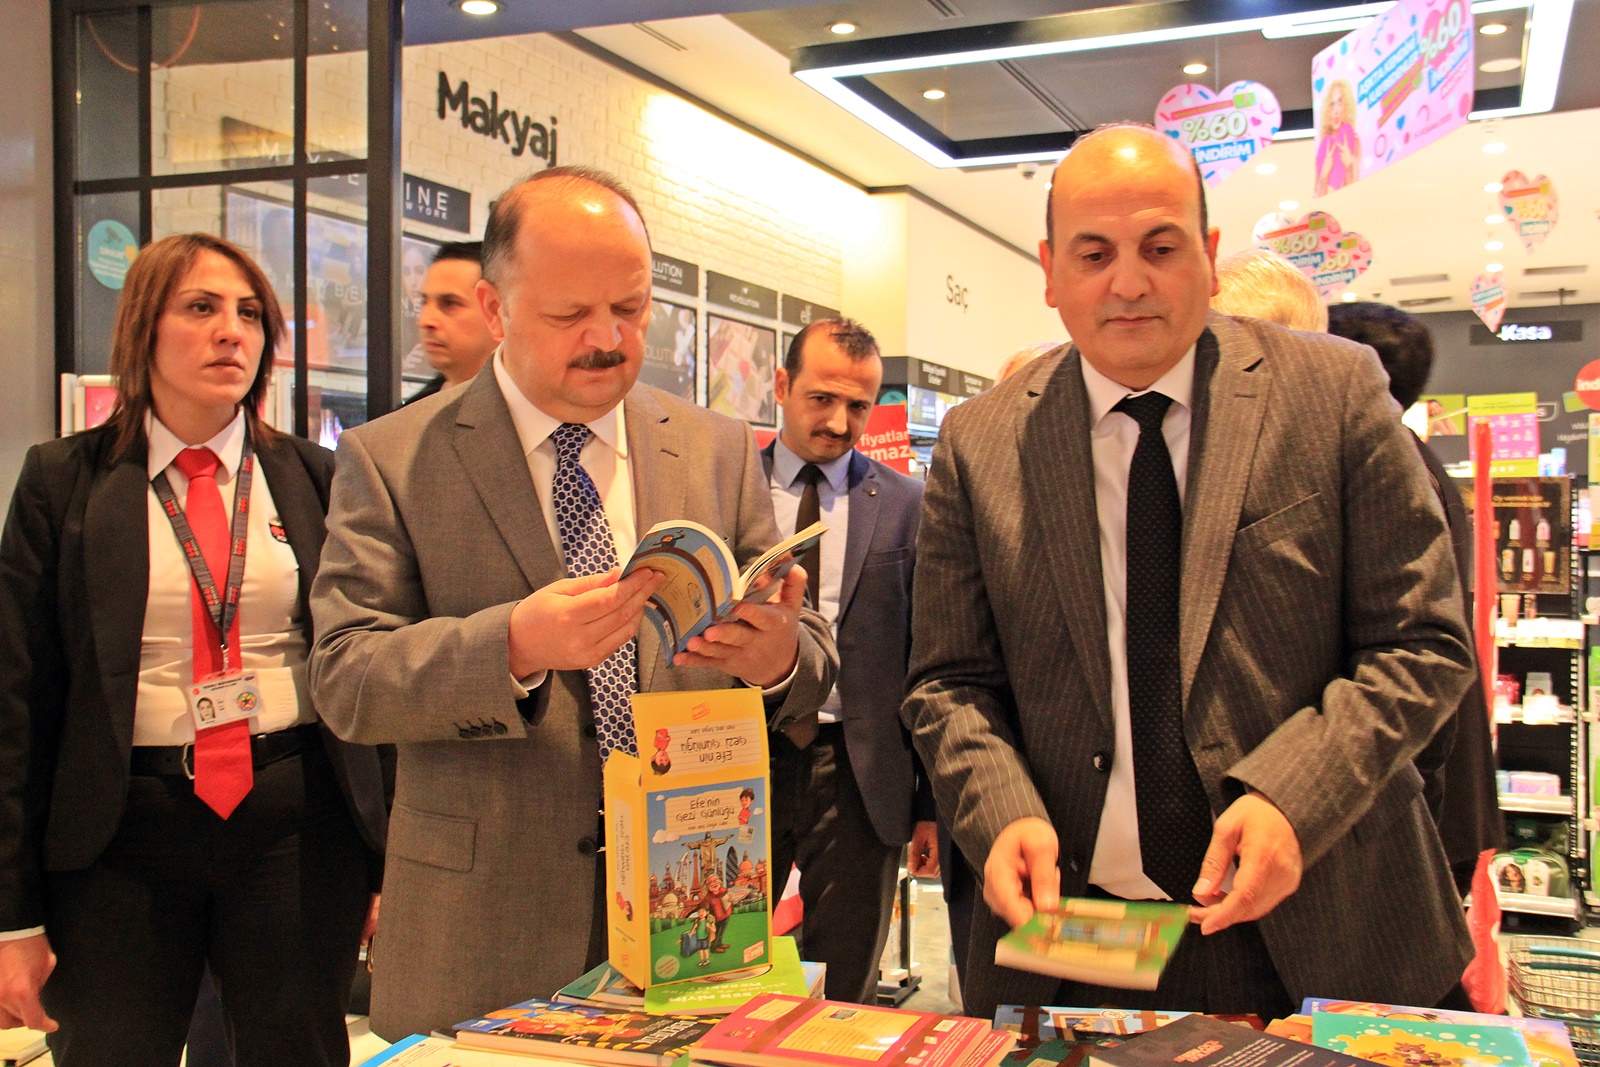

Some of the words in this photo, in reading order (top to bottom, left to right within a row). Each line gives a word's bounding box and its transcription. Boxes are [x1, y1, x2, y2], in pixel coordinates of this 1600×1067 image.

[438, 71, 558, 168] Makyaj
[1182, 111, 1248, 143] %60
[419, 206, 447, 220] YORK
[1515, 198, 1546, 219] %60
[1272, 232, 1319, 254] %60
[652, 260, 683, 279] LUTION
[946, 275, 968, 313] Saç
[1501, 324, 1552, 341] Kasa
[860, 430, 909, 447] fiyatlar
[690, 797, 720, 810] Efe'nin
